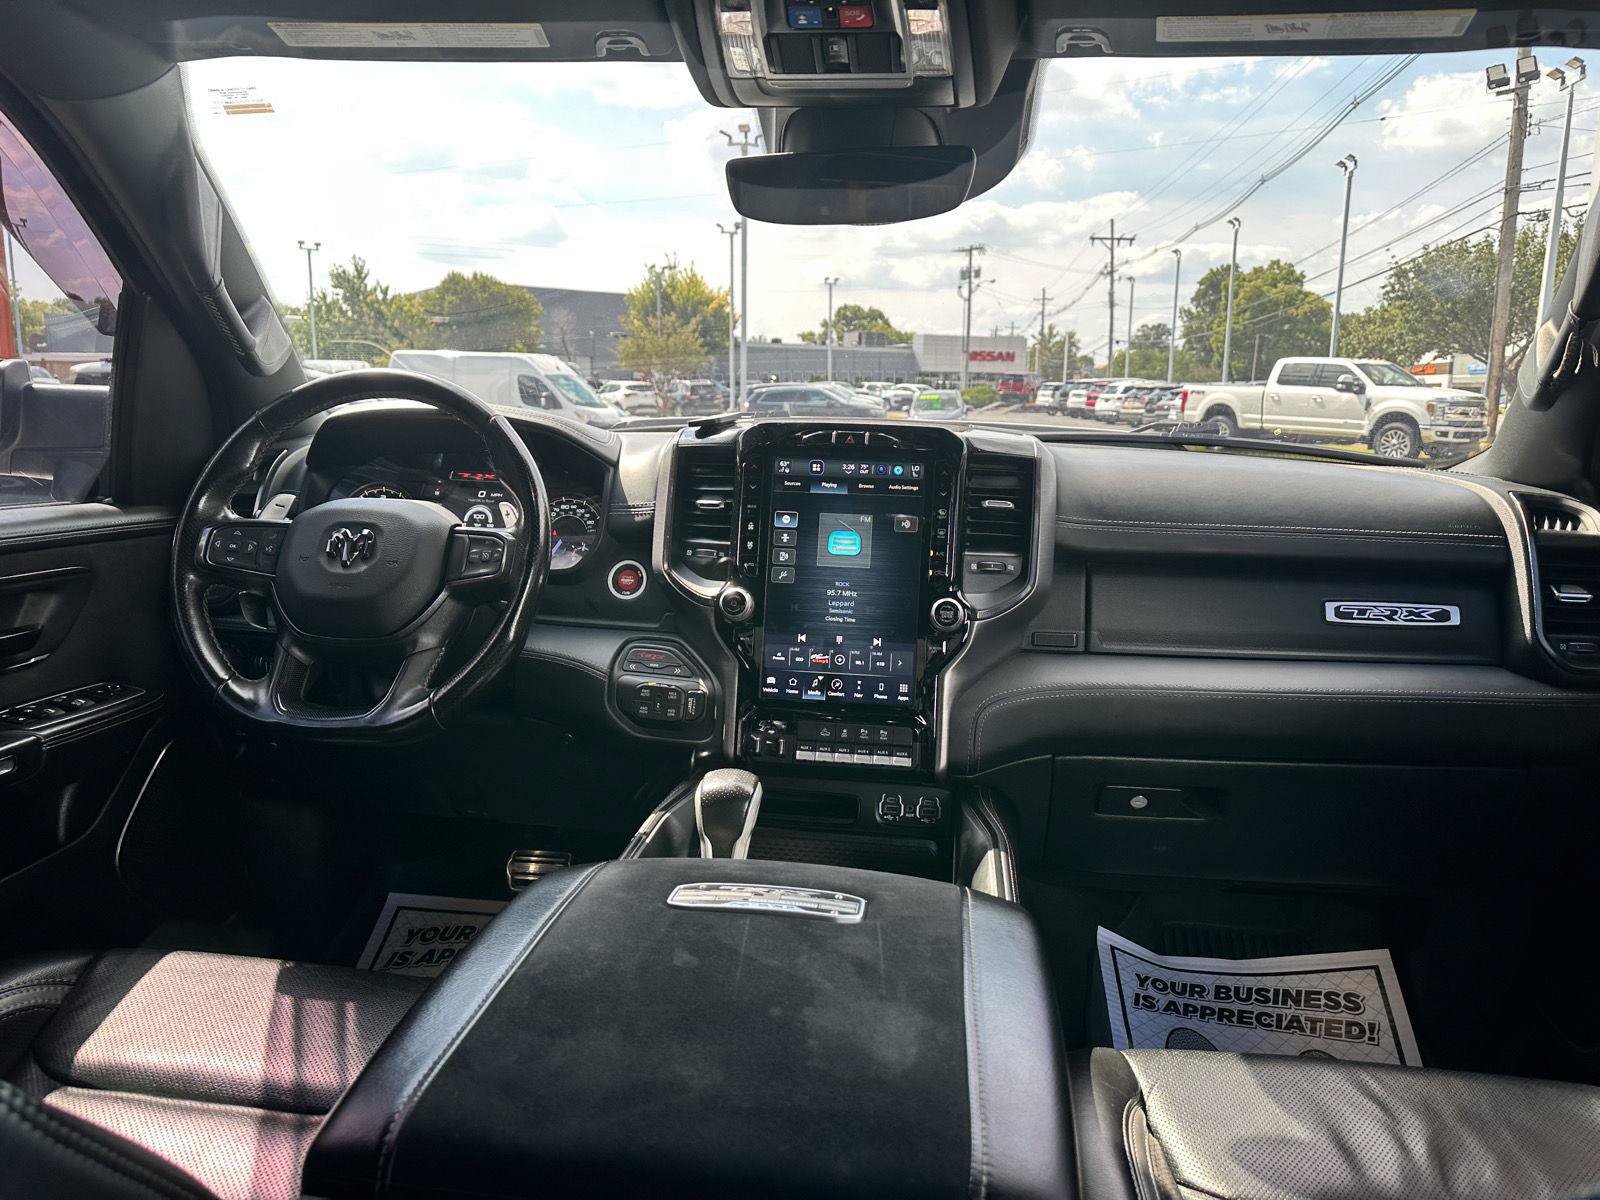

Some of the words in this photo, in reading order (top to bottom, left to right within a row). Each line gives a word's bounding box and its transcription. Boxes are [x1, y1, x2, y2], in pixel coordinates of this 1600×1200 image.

[968, 351, 1015, 362] NISSAN
[1339, 605, 1443, 622] TRX
[404, 924, 478, 945] YOUR
[383, 950, 413, 970] IS
[1134, 972, 1209, 1000] YOUR
[1212, 984, 1366, 1015] BUSINESS
[1132, 992, 1159, 1012] IS
[1161, 999, 1381, 1046] APPRECIATED!
